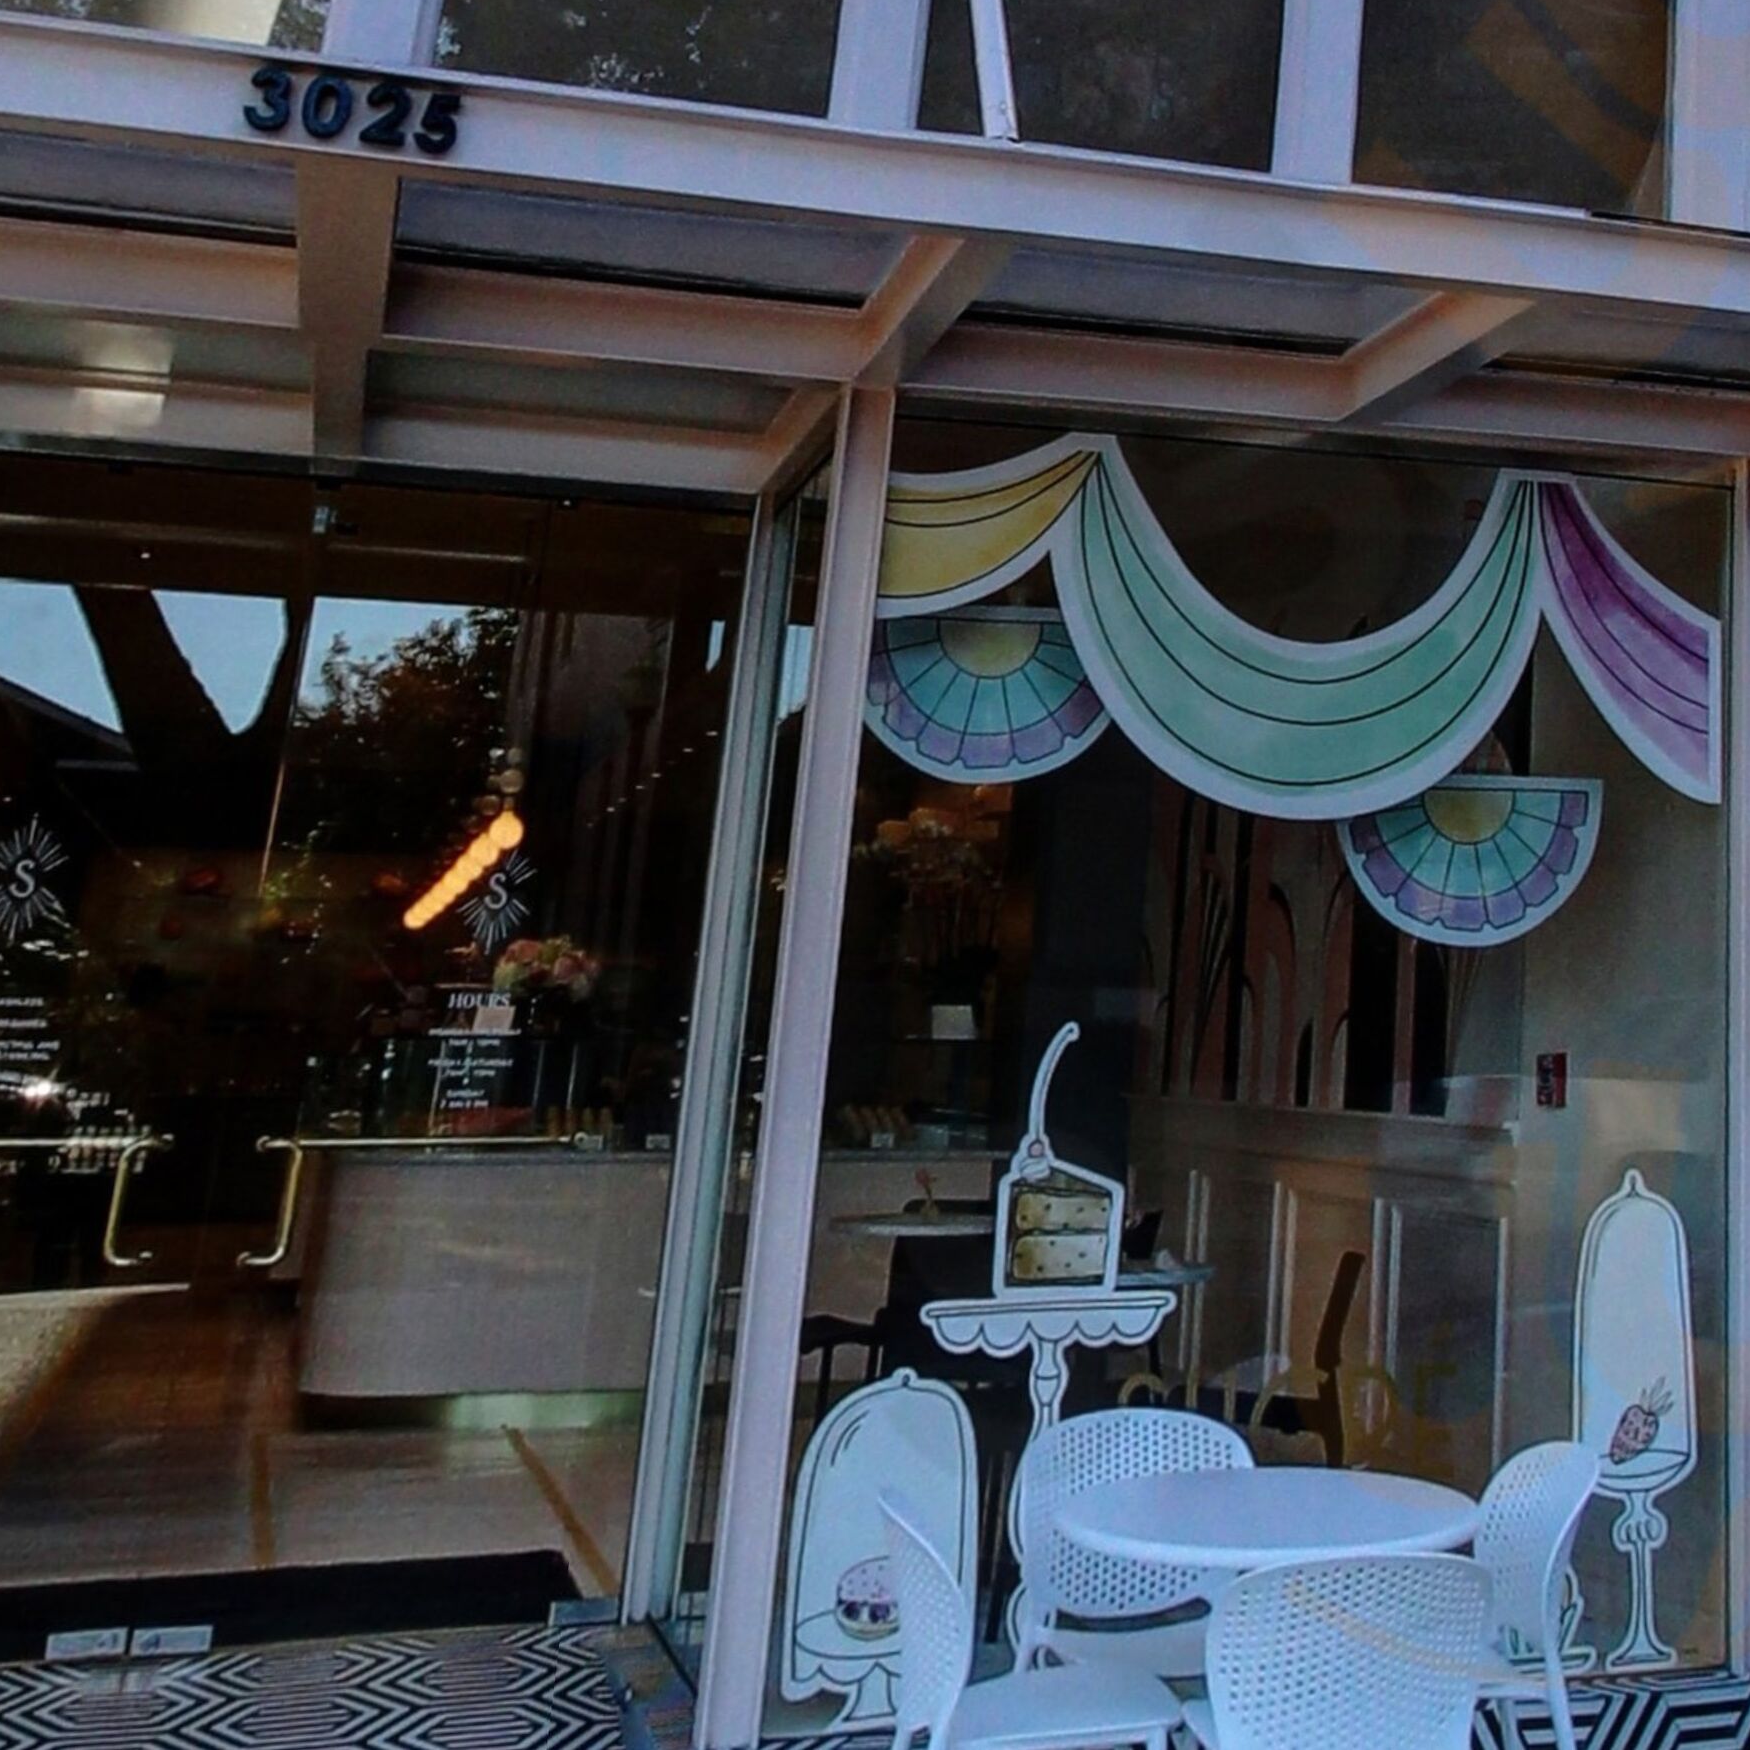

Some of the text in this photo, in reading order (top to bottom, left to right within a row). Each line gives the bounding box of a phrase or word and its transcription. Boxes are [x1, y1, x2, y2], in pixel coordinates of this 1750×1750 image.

[243, 64, 462, 155] 3025
[10, 859, 37, 899] S
[485, 873, 509, 909] S
[448, 992, 512, 1009] HOURS
